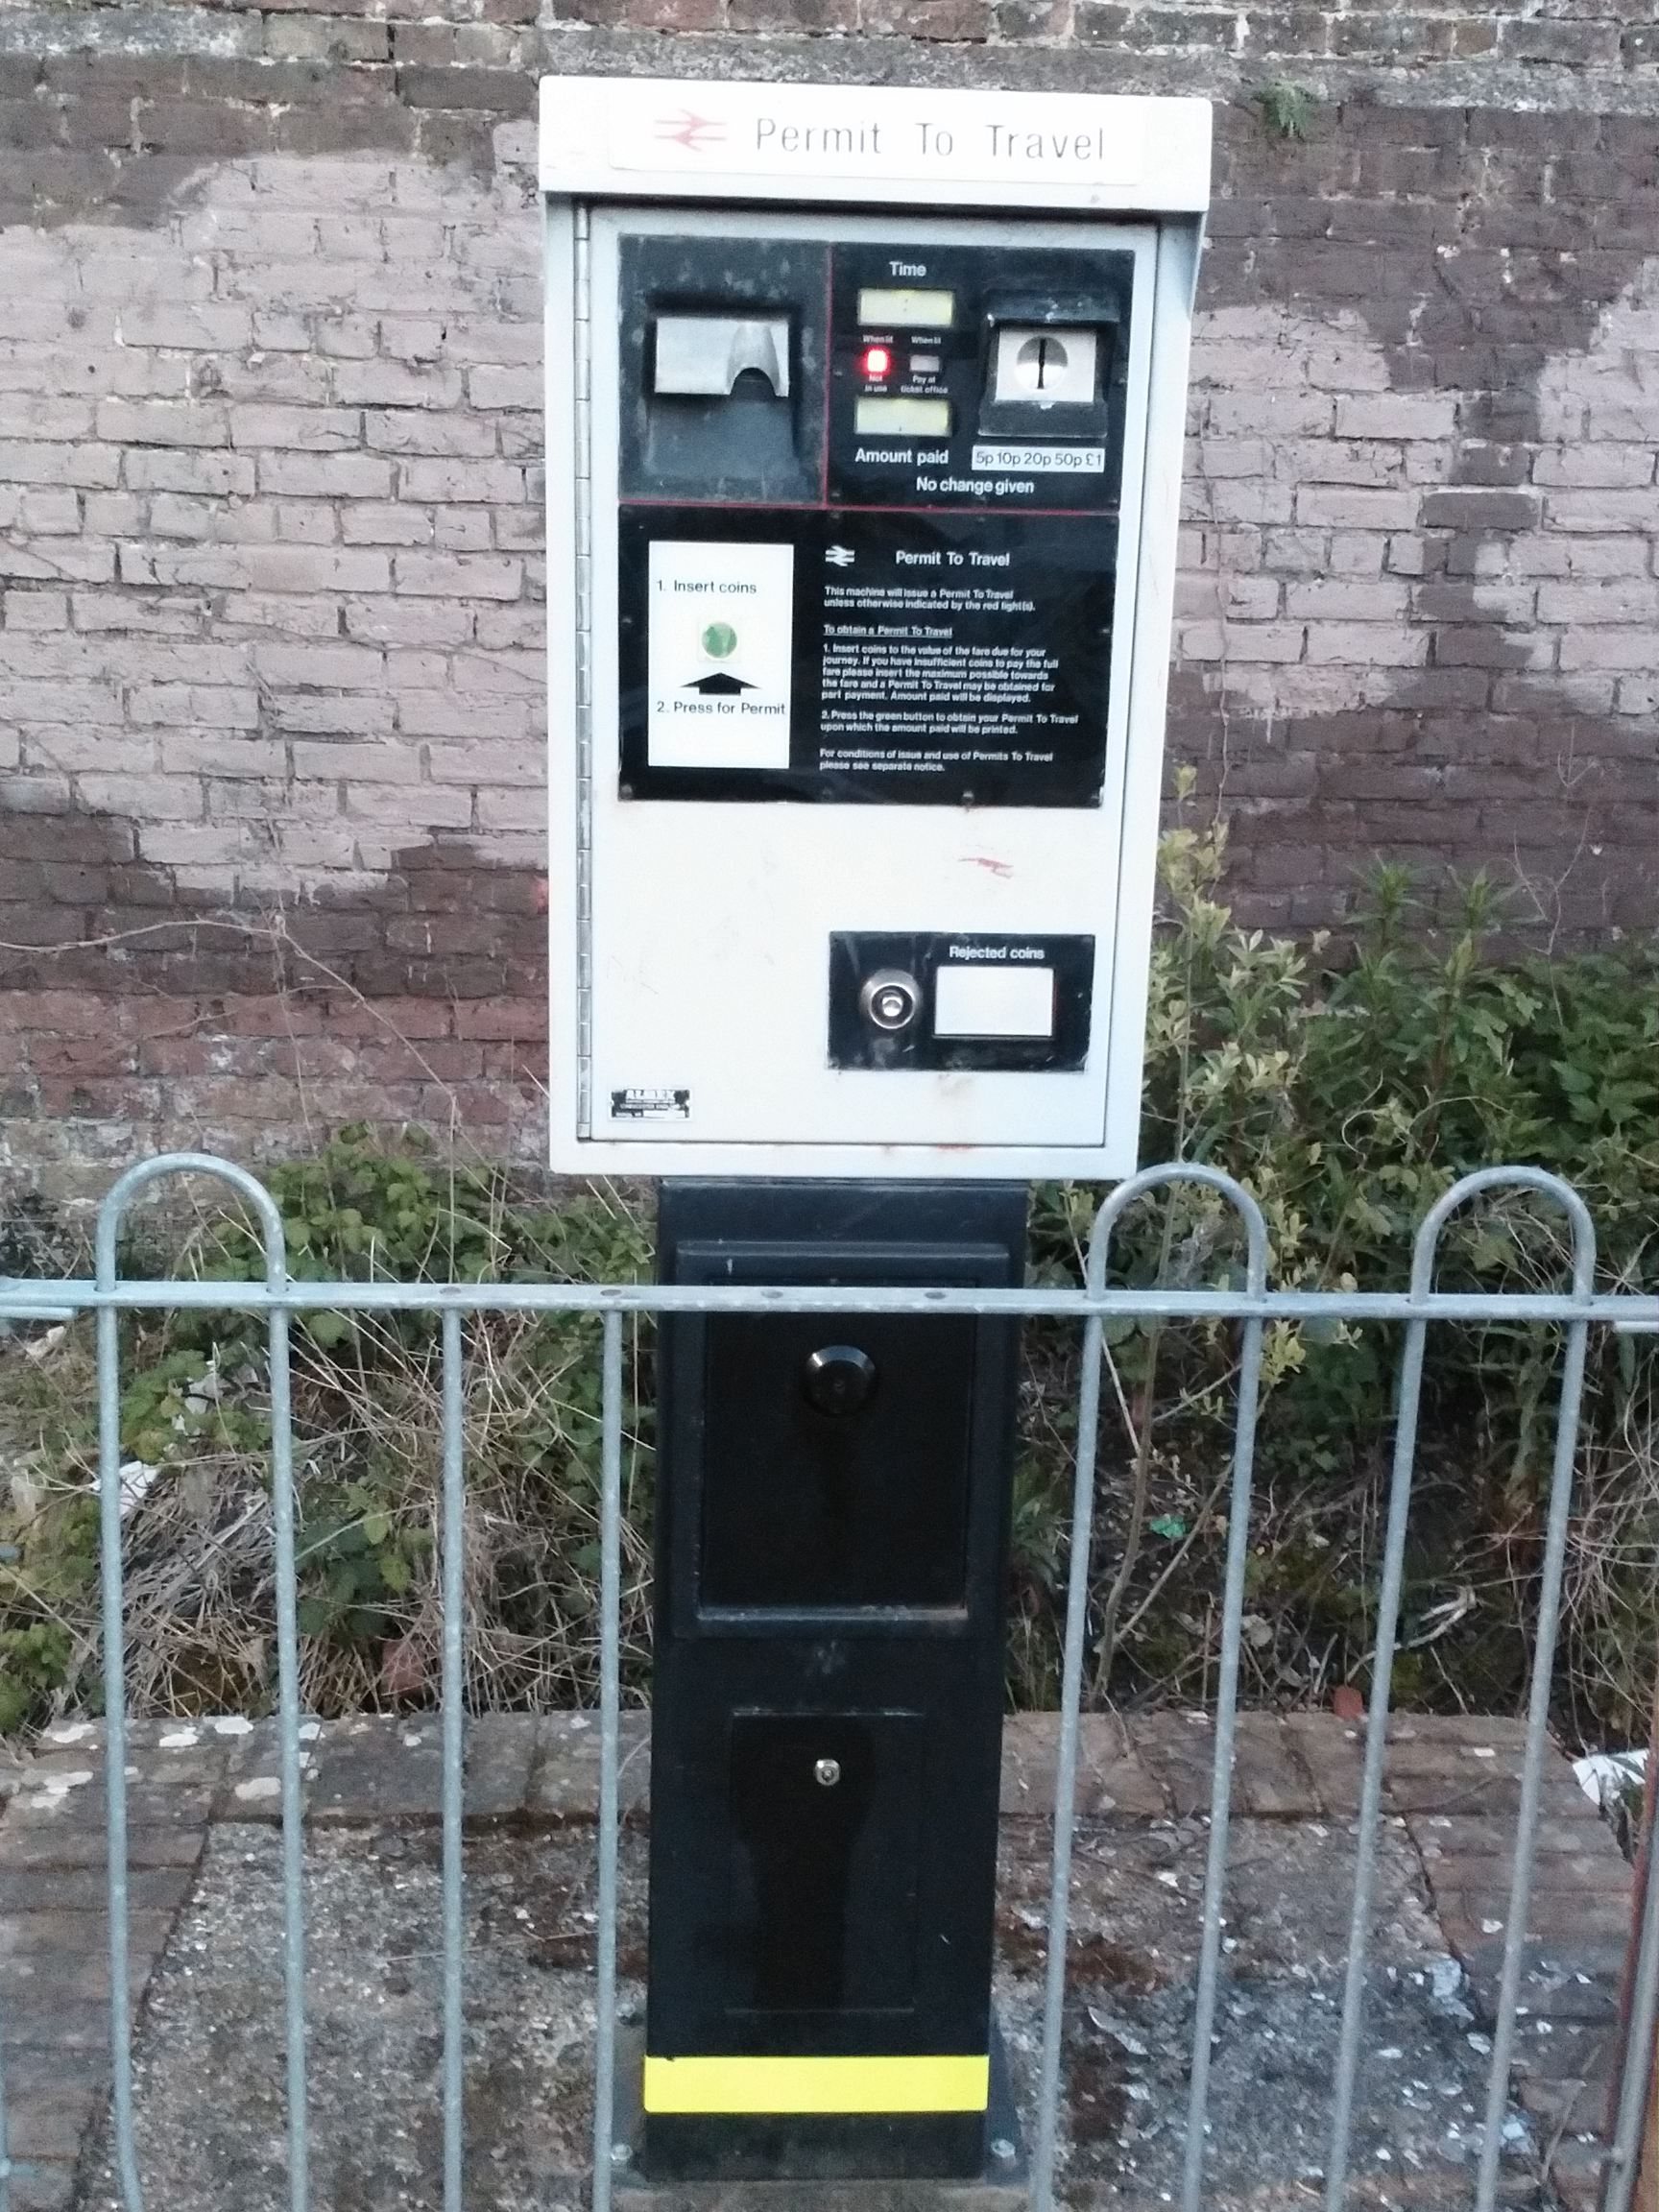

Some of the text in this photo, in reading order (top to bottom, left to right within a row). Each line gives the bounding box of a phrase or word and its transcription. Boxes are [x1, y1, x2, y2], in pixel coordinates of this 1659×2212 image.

[757, 117, 1105, 160] Permit To Travel
[889, 261, 927, 276] Time
[912, 374, 927, 384] Pay
[855, 447, 949, 466] Amount paid
[976, 452, 1101, 467] 5p 10p 20p 50p £1
[916, 477, 1035, 494] No change given
[896, 550, 1010, 566] Permit To Travel
[657, 580, 757, 593] 1. Insert coins
[825, 586, 844, 595] This
[846, 588, 885, 596] machine
[940, 589, 971, 598] Permit
[974, 589, 984, 598] To
[986, 589, 1014, 599] Travel
[824, 598, 854, 607] unless
[856, 599, 903, 608] otherwise
[905, 599, 949, 609] indicated
[951, 601, 962, 611] by
[965, 601, 981, 610] the
[824, 624, 834, 634] To
[837, 625, 866, 634] obtain
[878, 625, 908, 636] Permit
[912, 626, 922, 636] To
[925, 625, 952, 636] Travel
[833, 643, 859, 653] Insert
[862, 645, 886, 654] coins
[901, 645, 916, 654] the
[918, 646, 941, 656] value
[943, 646, 952, 655] of
[955, 646, 970, 655] the
[972, 647, 990, 656] fare
[992, 646, 1009, 656] due
[1010, 647, 1023, 656] for
[1025, 649, 1046, 658] your
[823, 656, 1058, 669] journey. If you have insufficient coins to pay the full
[823, 667, 840, 676] fare
[843, 667, 874, 678] please
[876, 668, 902, 677] insert
[905, 668, 921, 677] the
[969, 671, 1008, 680] possible
[1011, 671, 1048, 680] towards
[823, 678, 837, 687] the
[840, 679, 858, 687] fare
[861, 680, 878, 688] and
[888, 680, 919, 689] Permit
[922, 680, 932, 689] To
[934, 680, 961, 690] Travel
[963, 682, 982, 691] may
[984, 681, 996, 690] be
[998, 683, 1039, 691] obtained
[822, 690, 1030, 704] part payment. Amount paid will be displayed.
[657, 701, 785, 715] 2. Press for Permit
[821, 709, 1078, 724] 2. Press the green button to obtain your Permit To Travel
[821, 722, 1018, 734] upon which the amount paid will be printed.
[820, 748, 835, 757] For
[837, 750, 885, 758] conditions
[887, 750, 897, 758] of
[924, 751, 941, 759] and
[974, 751, 1008, 760] Permits
[1011, 751, 1022, 760] To
[1025, 751, 1053, 761] Travel
[820, 761, 850, 770] please
[872, 762, 912, 771] separate
[914, 762, 945, 771] notice.
[950, 946, 1045, 960] Rejected coins
